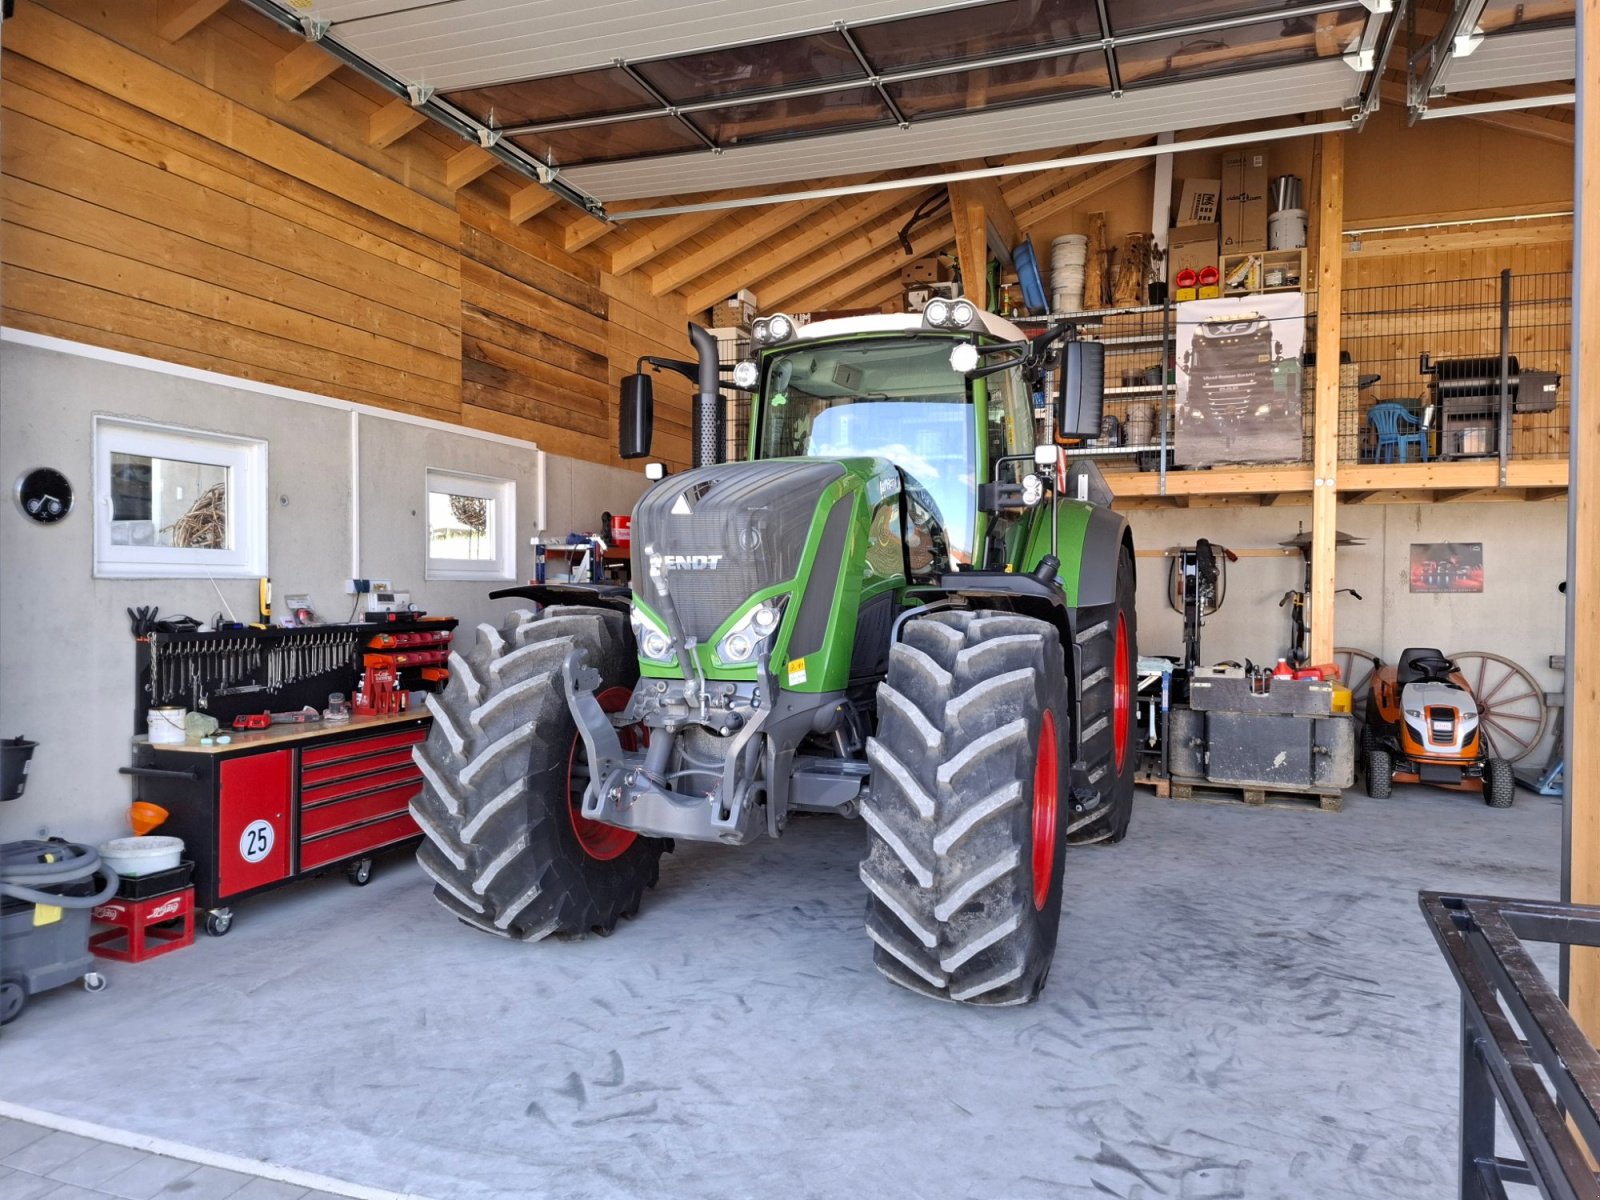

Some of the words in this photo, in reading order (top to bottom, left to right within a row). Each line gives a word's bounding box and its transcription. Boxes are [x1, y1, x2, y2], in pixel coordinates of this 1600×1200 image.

[1215, 322, 1249, 335] XF
[650, 554, 723, 570] ENDT
[247, 827, 267, 856] 25
